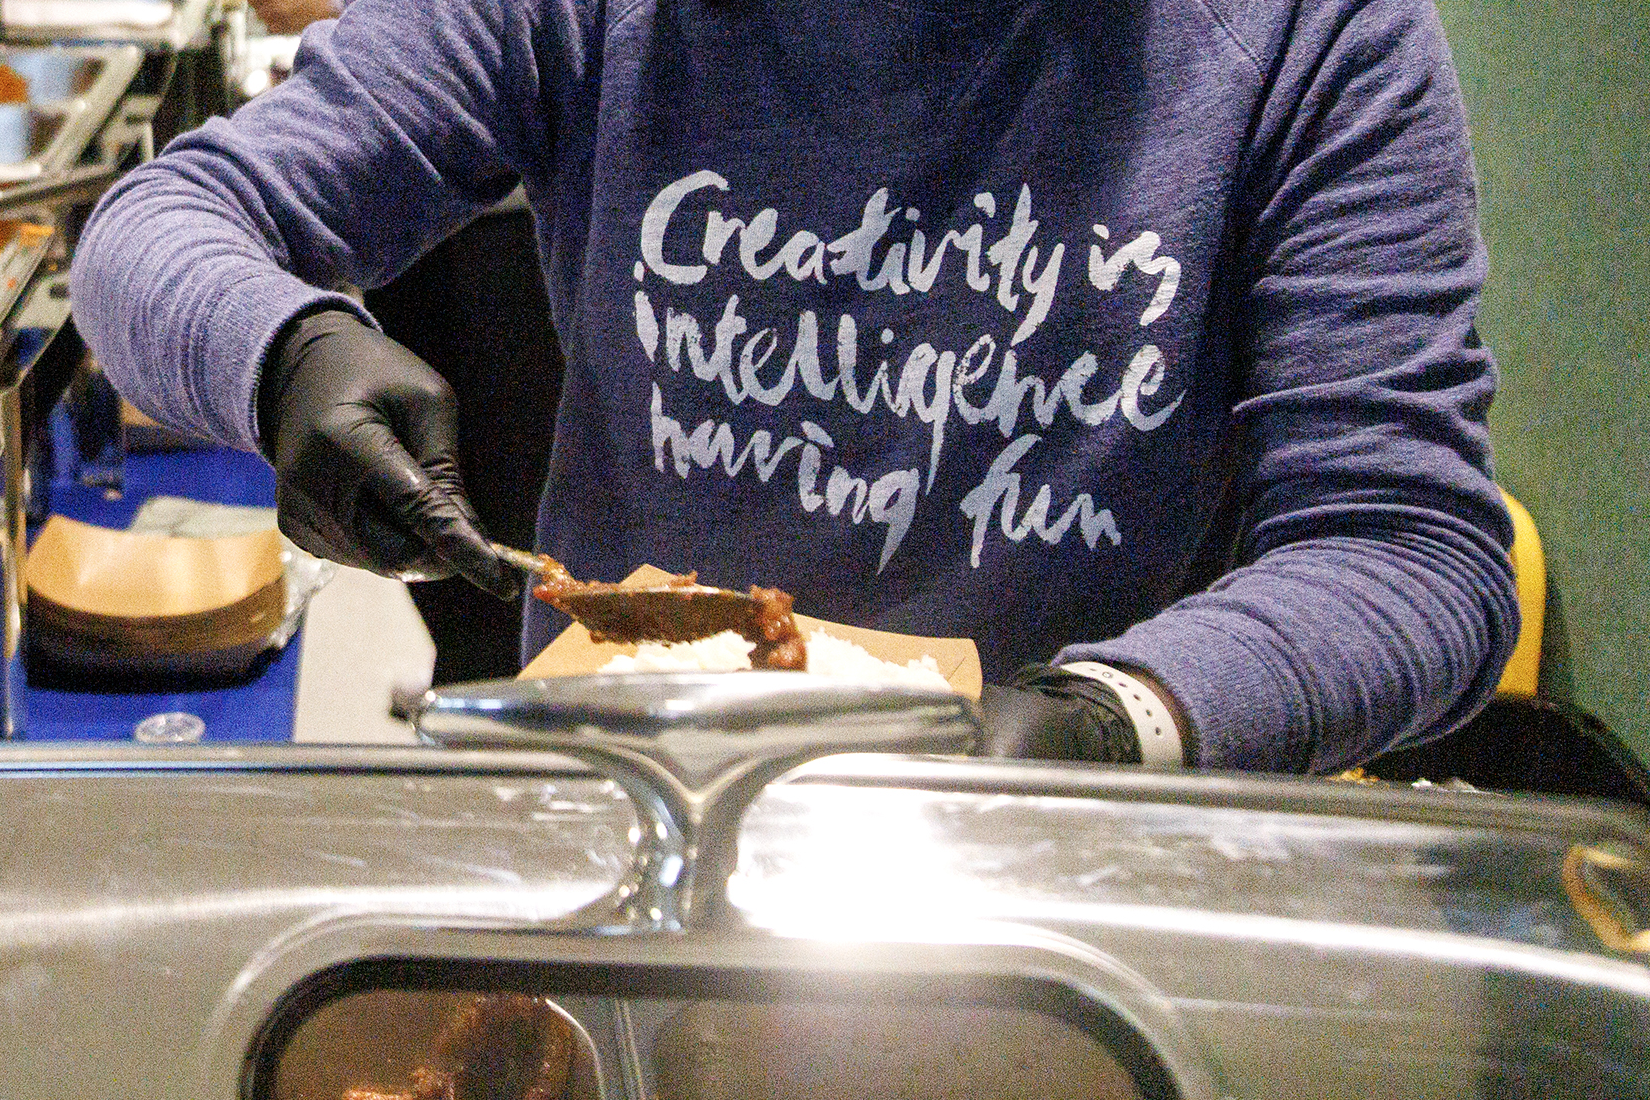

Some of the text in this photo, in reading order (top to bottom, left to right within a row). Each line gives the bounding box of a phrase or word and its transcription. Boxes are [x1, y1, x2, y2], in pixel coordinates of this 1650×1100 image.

[639, 169, 1183, 347] Creativity is
[631, 259, 1187, 496] intelligence
[649, 380, 1123, 577] having fun
